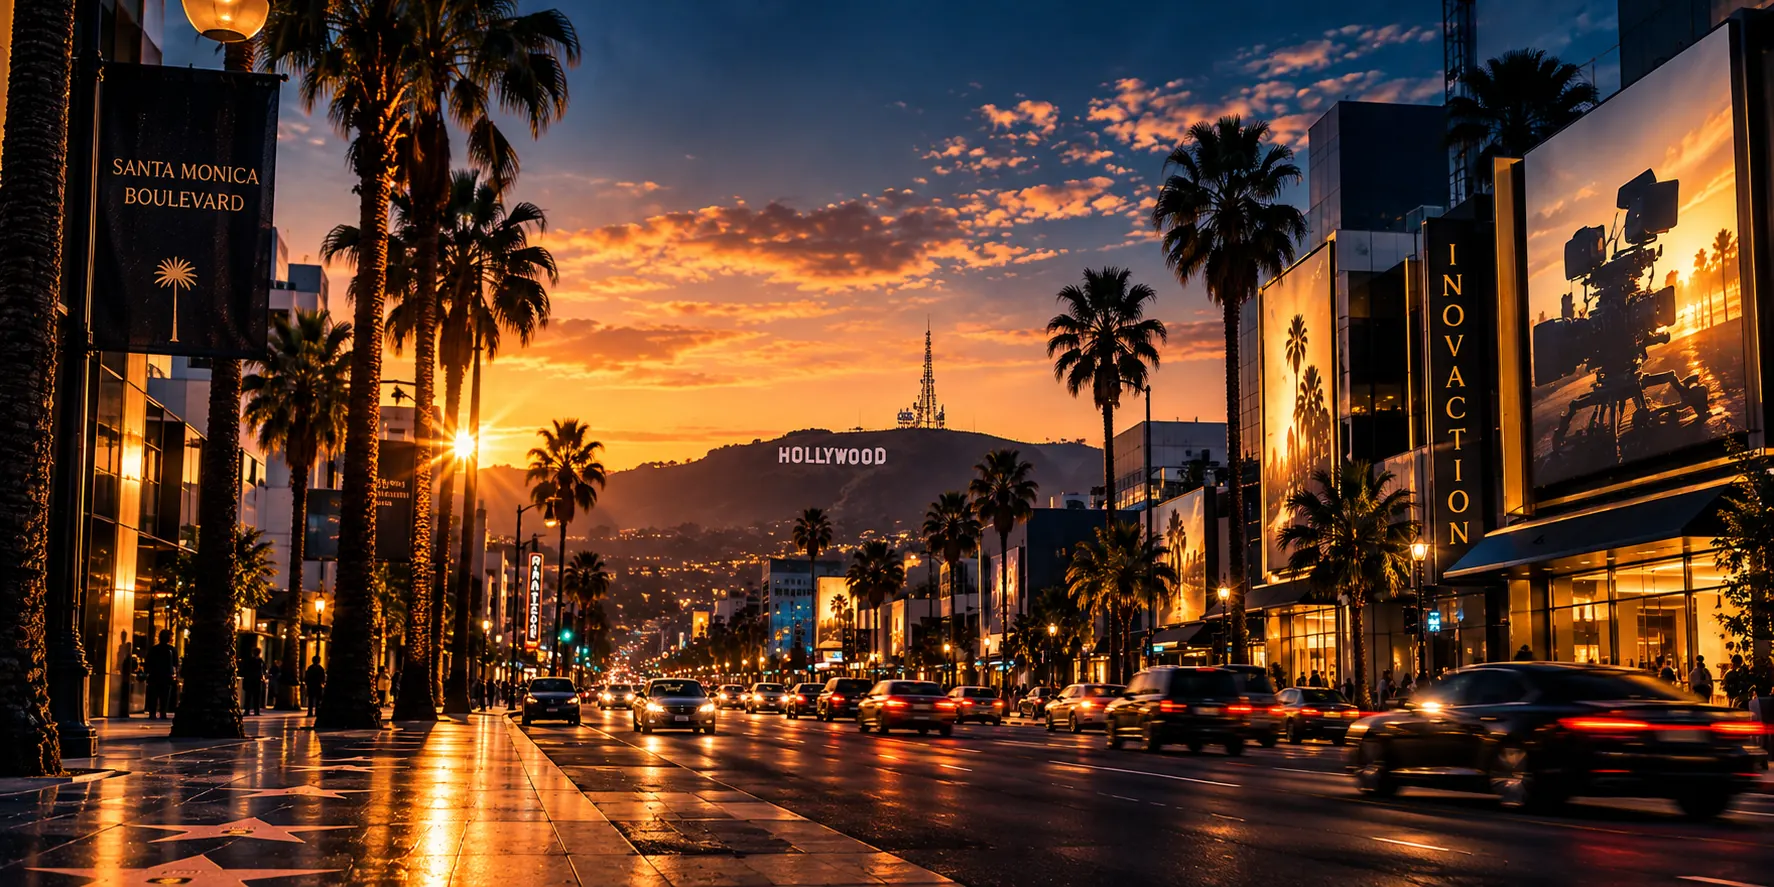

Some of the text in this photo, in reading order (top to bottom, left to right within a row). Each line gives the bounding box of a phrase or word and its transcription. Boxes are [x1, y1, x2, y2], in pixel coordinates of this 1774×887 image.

[112, 158, 260, 185] SANTA MONICA
[124, 187, 245, 212] BOULEVARD
[1442, 243, 1470, 545] INOVACTION
[778, 446, 887, 465] HOLLYWOOD
